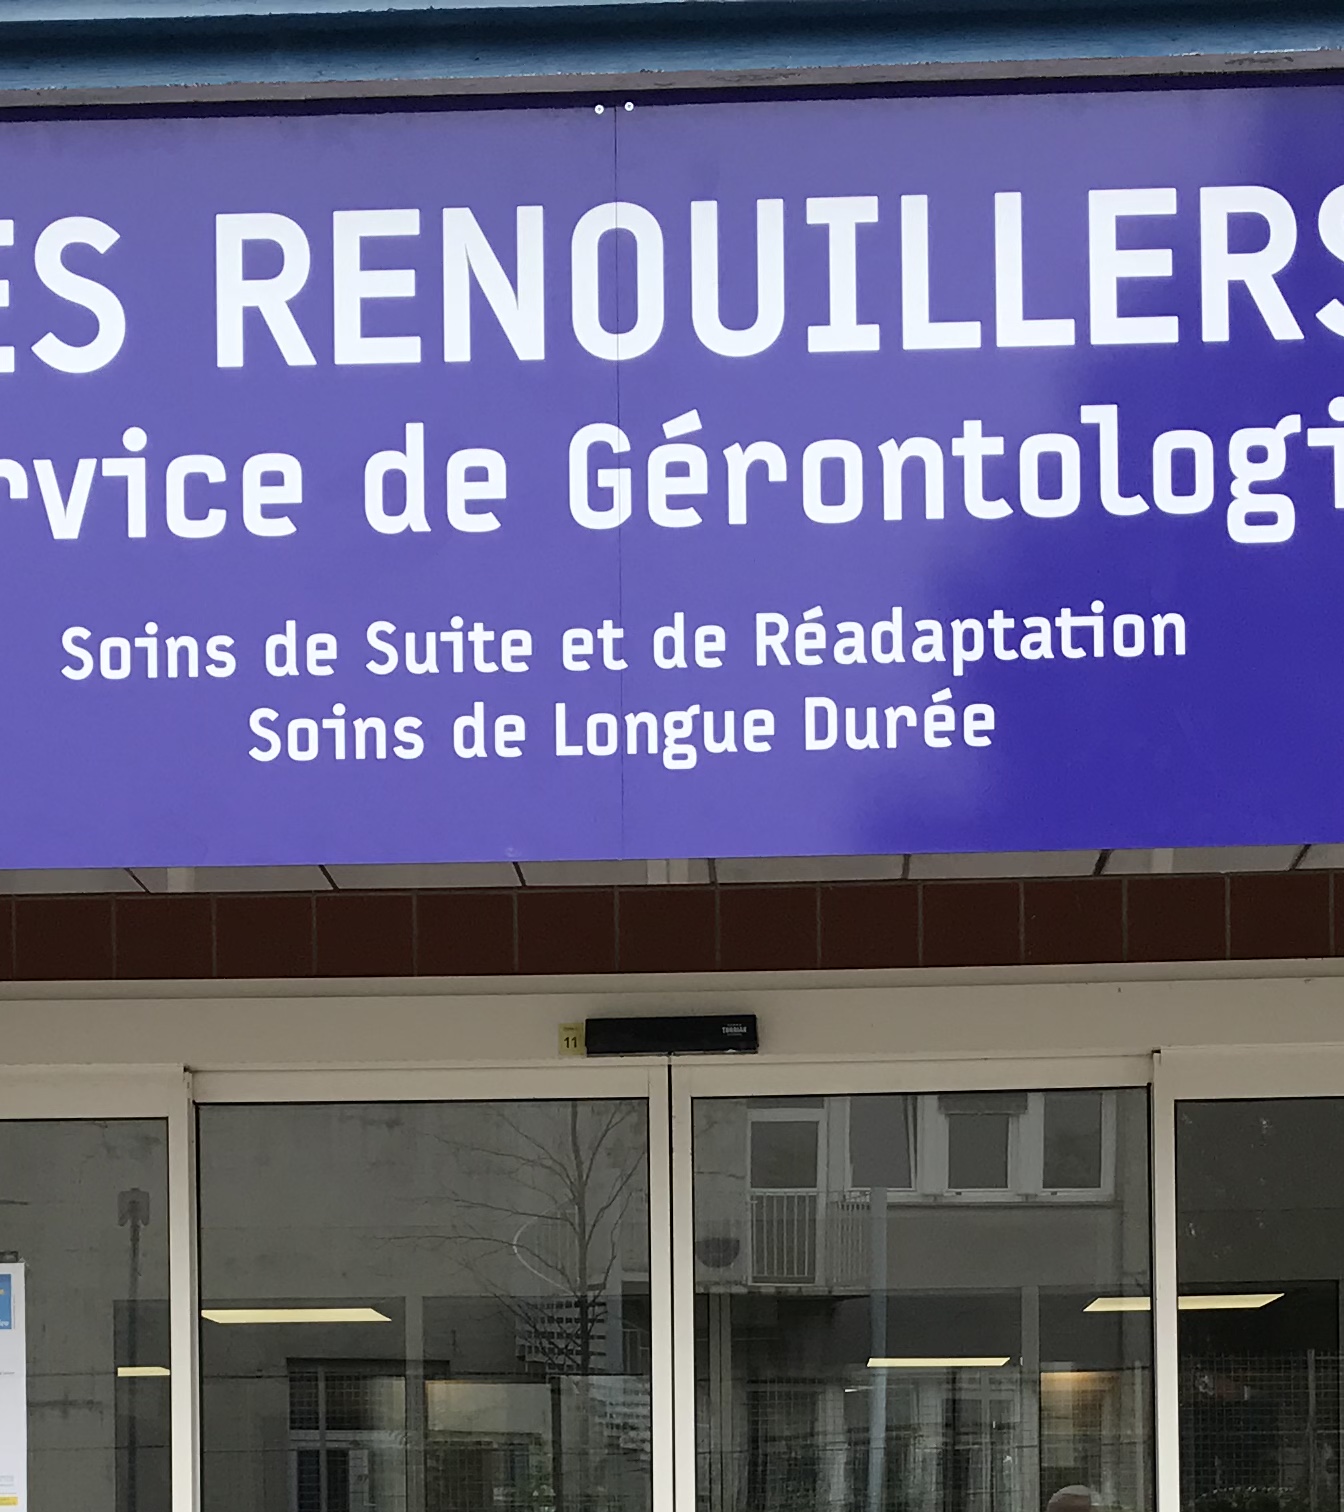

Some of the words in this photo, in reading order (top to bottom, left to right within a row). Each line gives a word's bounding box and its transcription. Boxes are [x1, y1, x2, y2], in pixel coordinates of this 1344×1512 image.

[364, 422, 508, 535] de
[61, 621, 237, 681] Soins
[265, 619, 338, 677] de
[365, 615, 533, 675] Suite
[562, 619, 629, 672] et
[653, 611, 726, 670] de
[755, 599, 1186, 677] Réadaptation
[248, 702, 425, 762] Soins
[453, 701, 526, 759] de
[555, 702, 775, 770] Longue
[804, 687, 995, 751] Durée
[564, 1036, 577, 1048] 11
